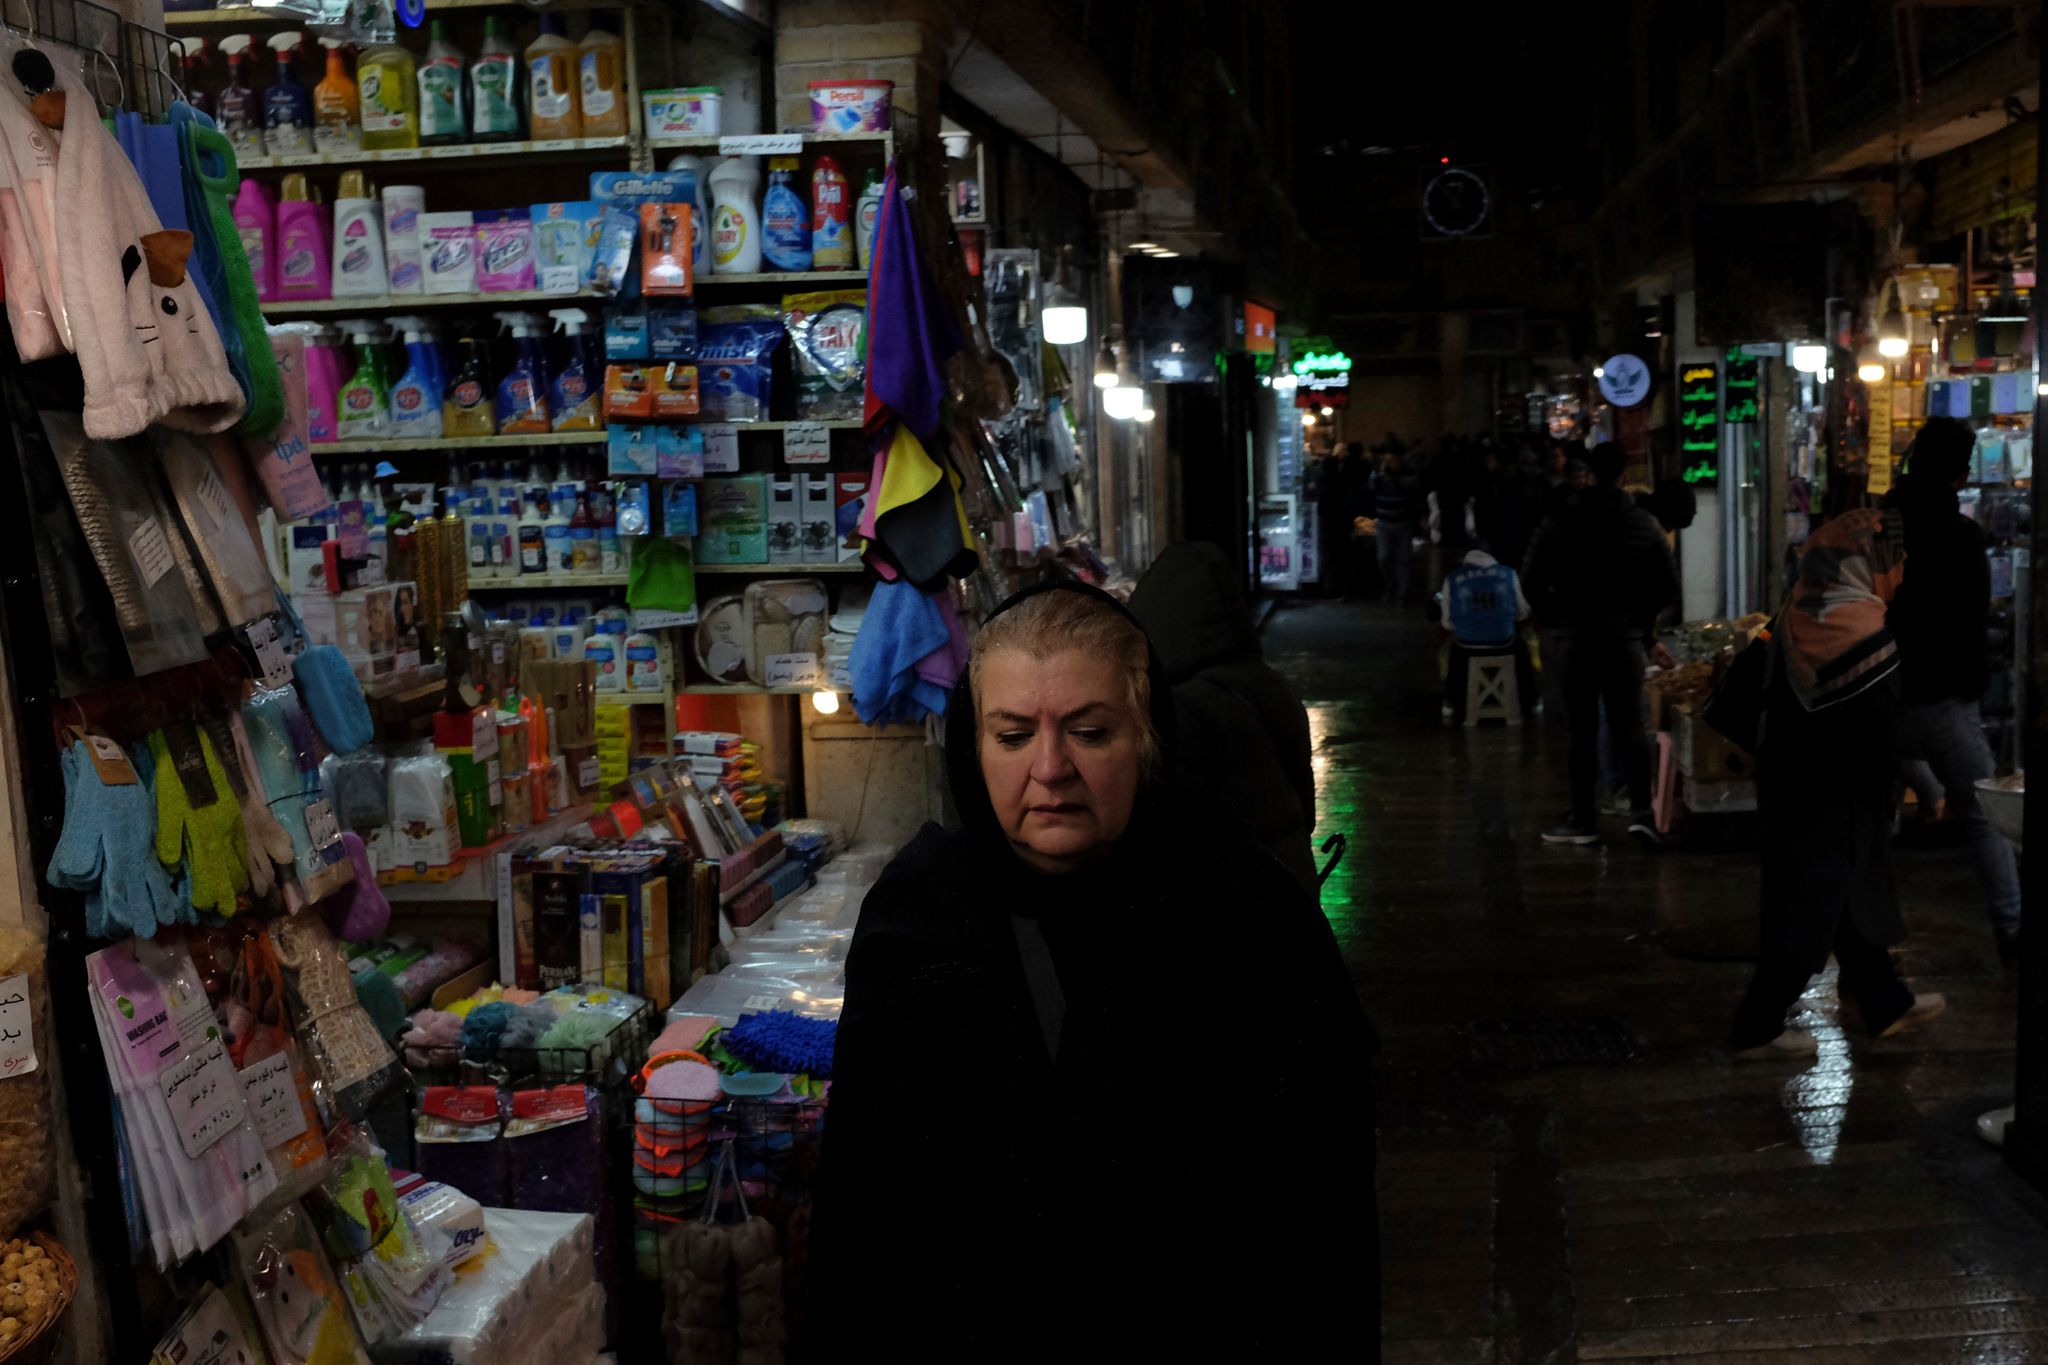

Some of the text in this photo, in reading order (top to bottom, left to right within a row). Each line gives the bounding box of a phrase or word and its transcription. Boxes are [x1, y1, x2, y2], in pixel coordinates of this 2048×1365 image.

[830, 90, 865, 102] Persil
[613, 180, 674, 196] Gillette
[126, 1018, 154, 1042] WASHING
[154, 1010, 169, 1026] BAG
